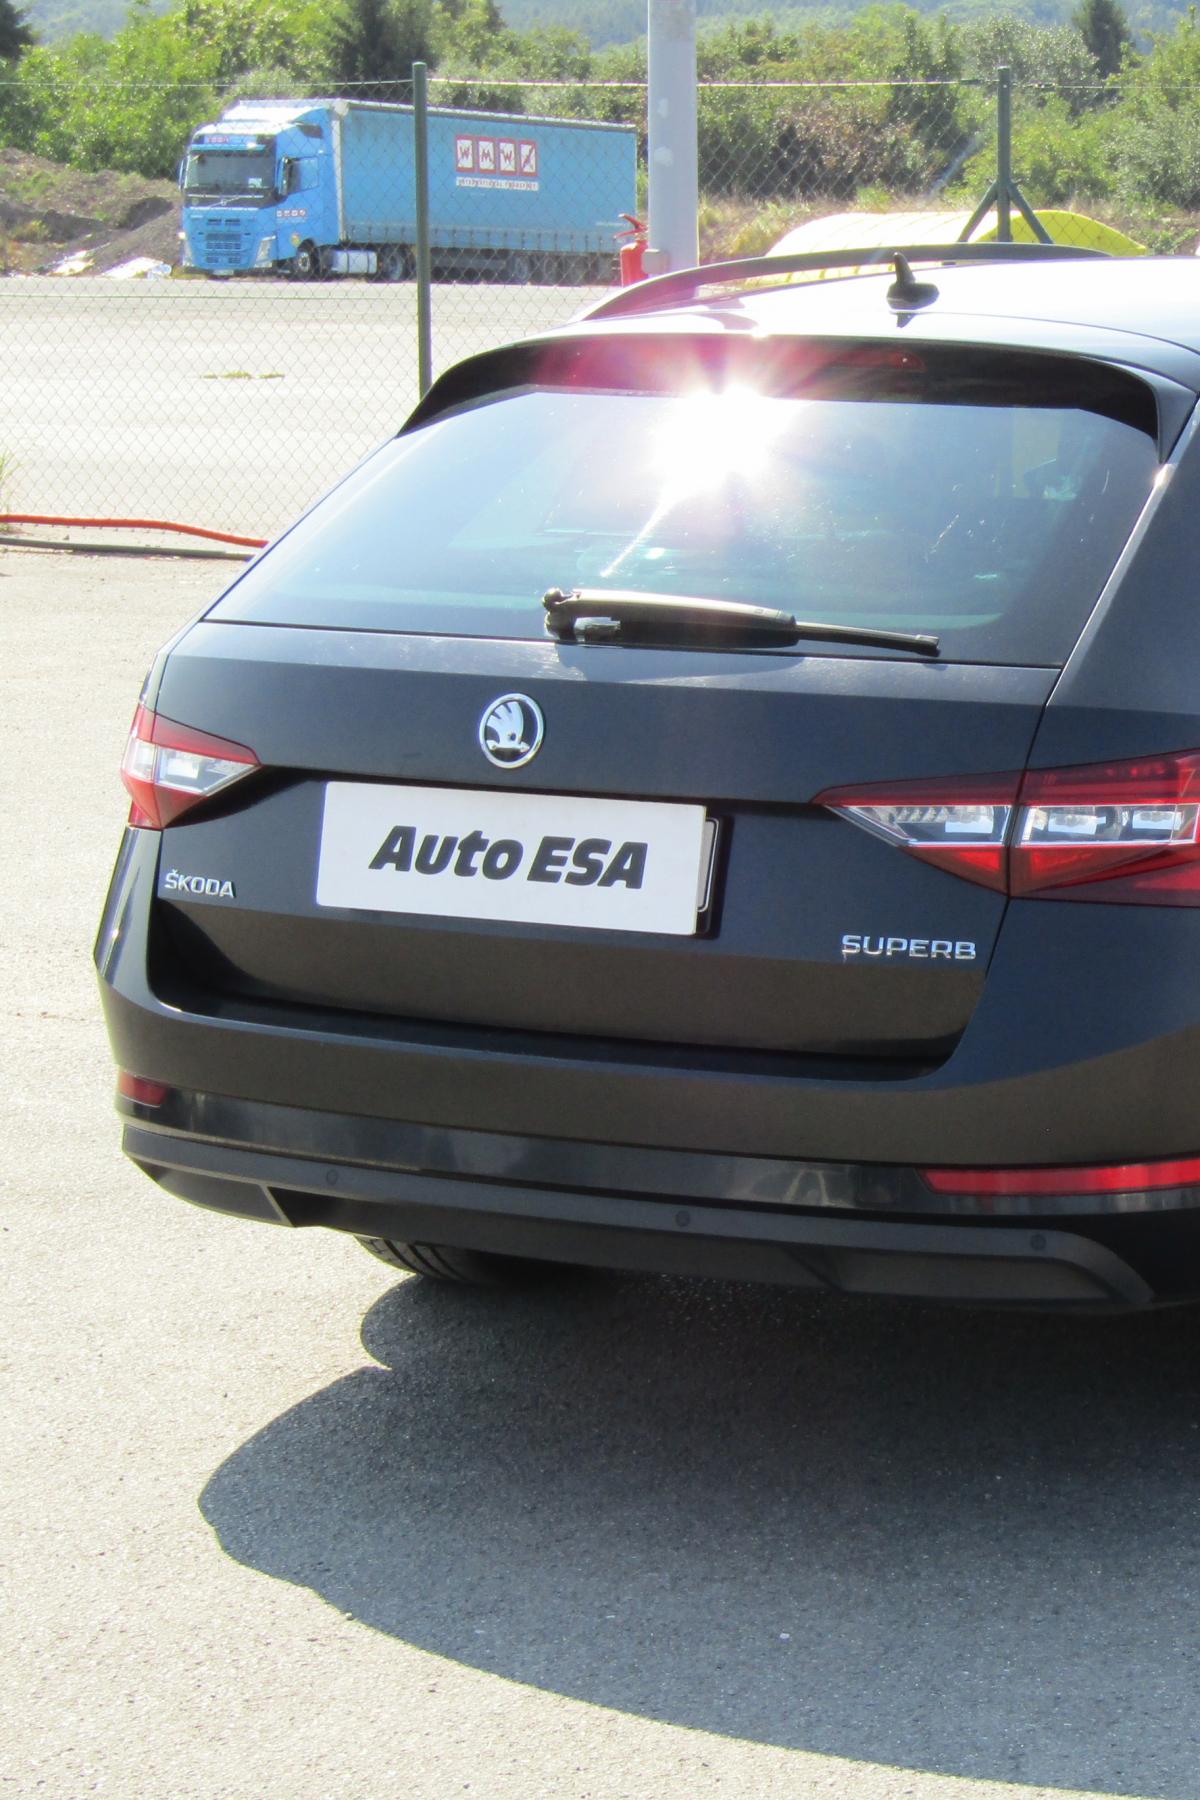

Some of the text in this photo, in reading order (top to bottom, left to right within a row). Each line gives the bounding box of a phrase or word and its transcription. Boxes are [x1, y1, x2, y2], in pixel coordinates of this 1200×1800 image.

[368, 825, 648, 889] Auto ESA
[164, 869, 234, 898] ŠKODA
[841, 934, 977, 960] SUPERB
